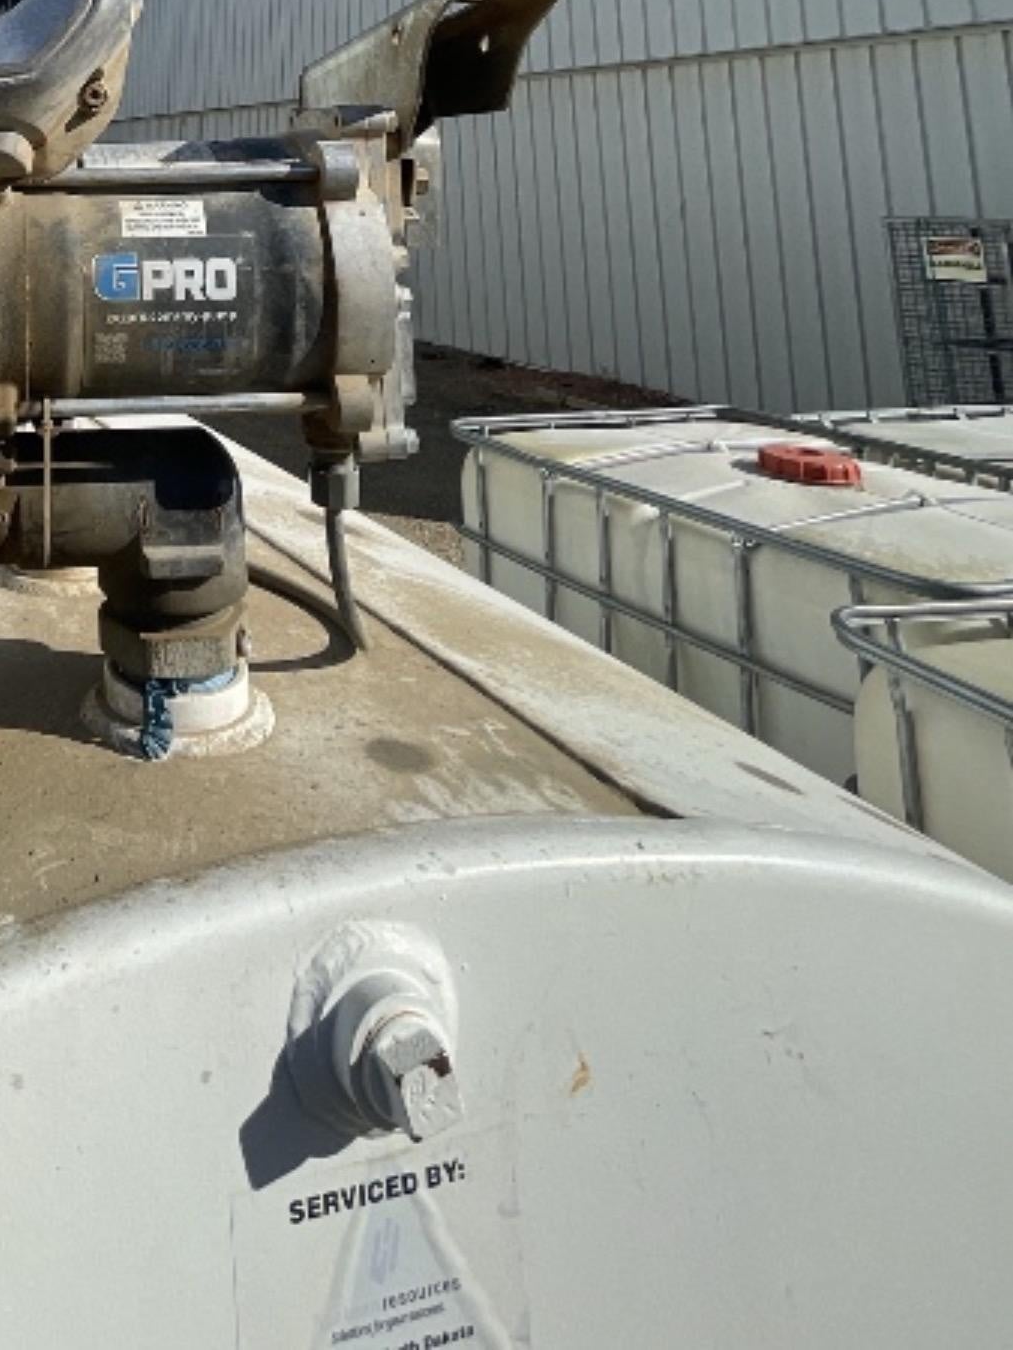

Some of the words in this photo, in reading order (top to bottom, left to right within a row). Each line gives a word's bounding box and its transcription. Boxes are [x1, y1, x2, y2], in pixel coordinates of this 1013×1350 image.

[289, 1171, 418, 1225] SERVICED
[425, 1157, 466, 1189] BY:
[382, 1277, 462, 1312] resources
